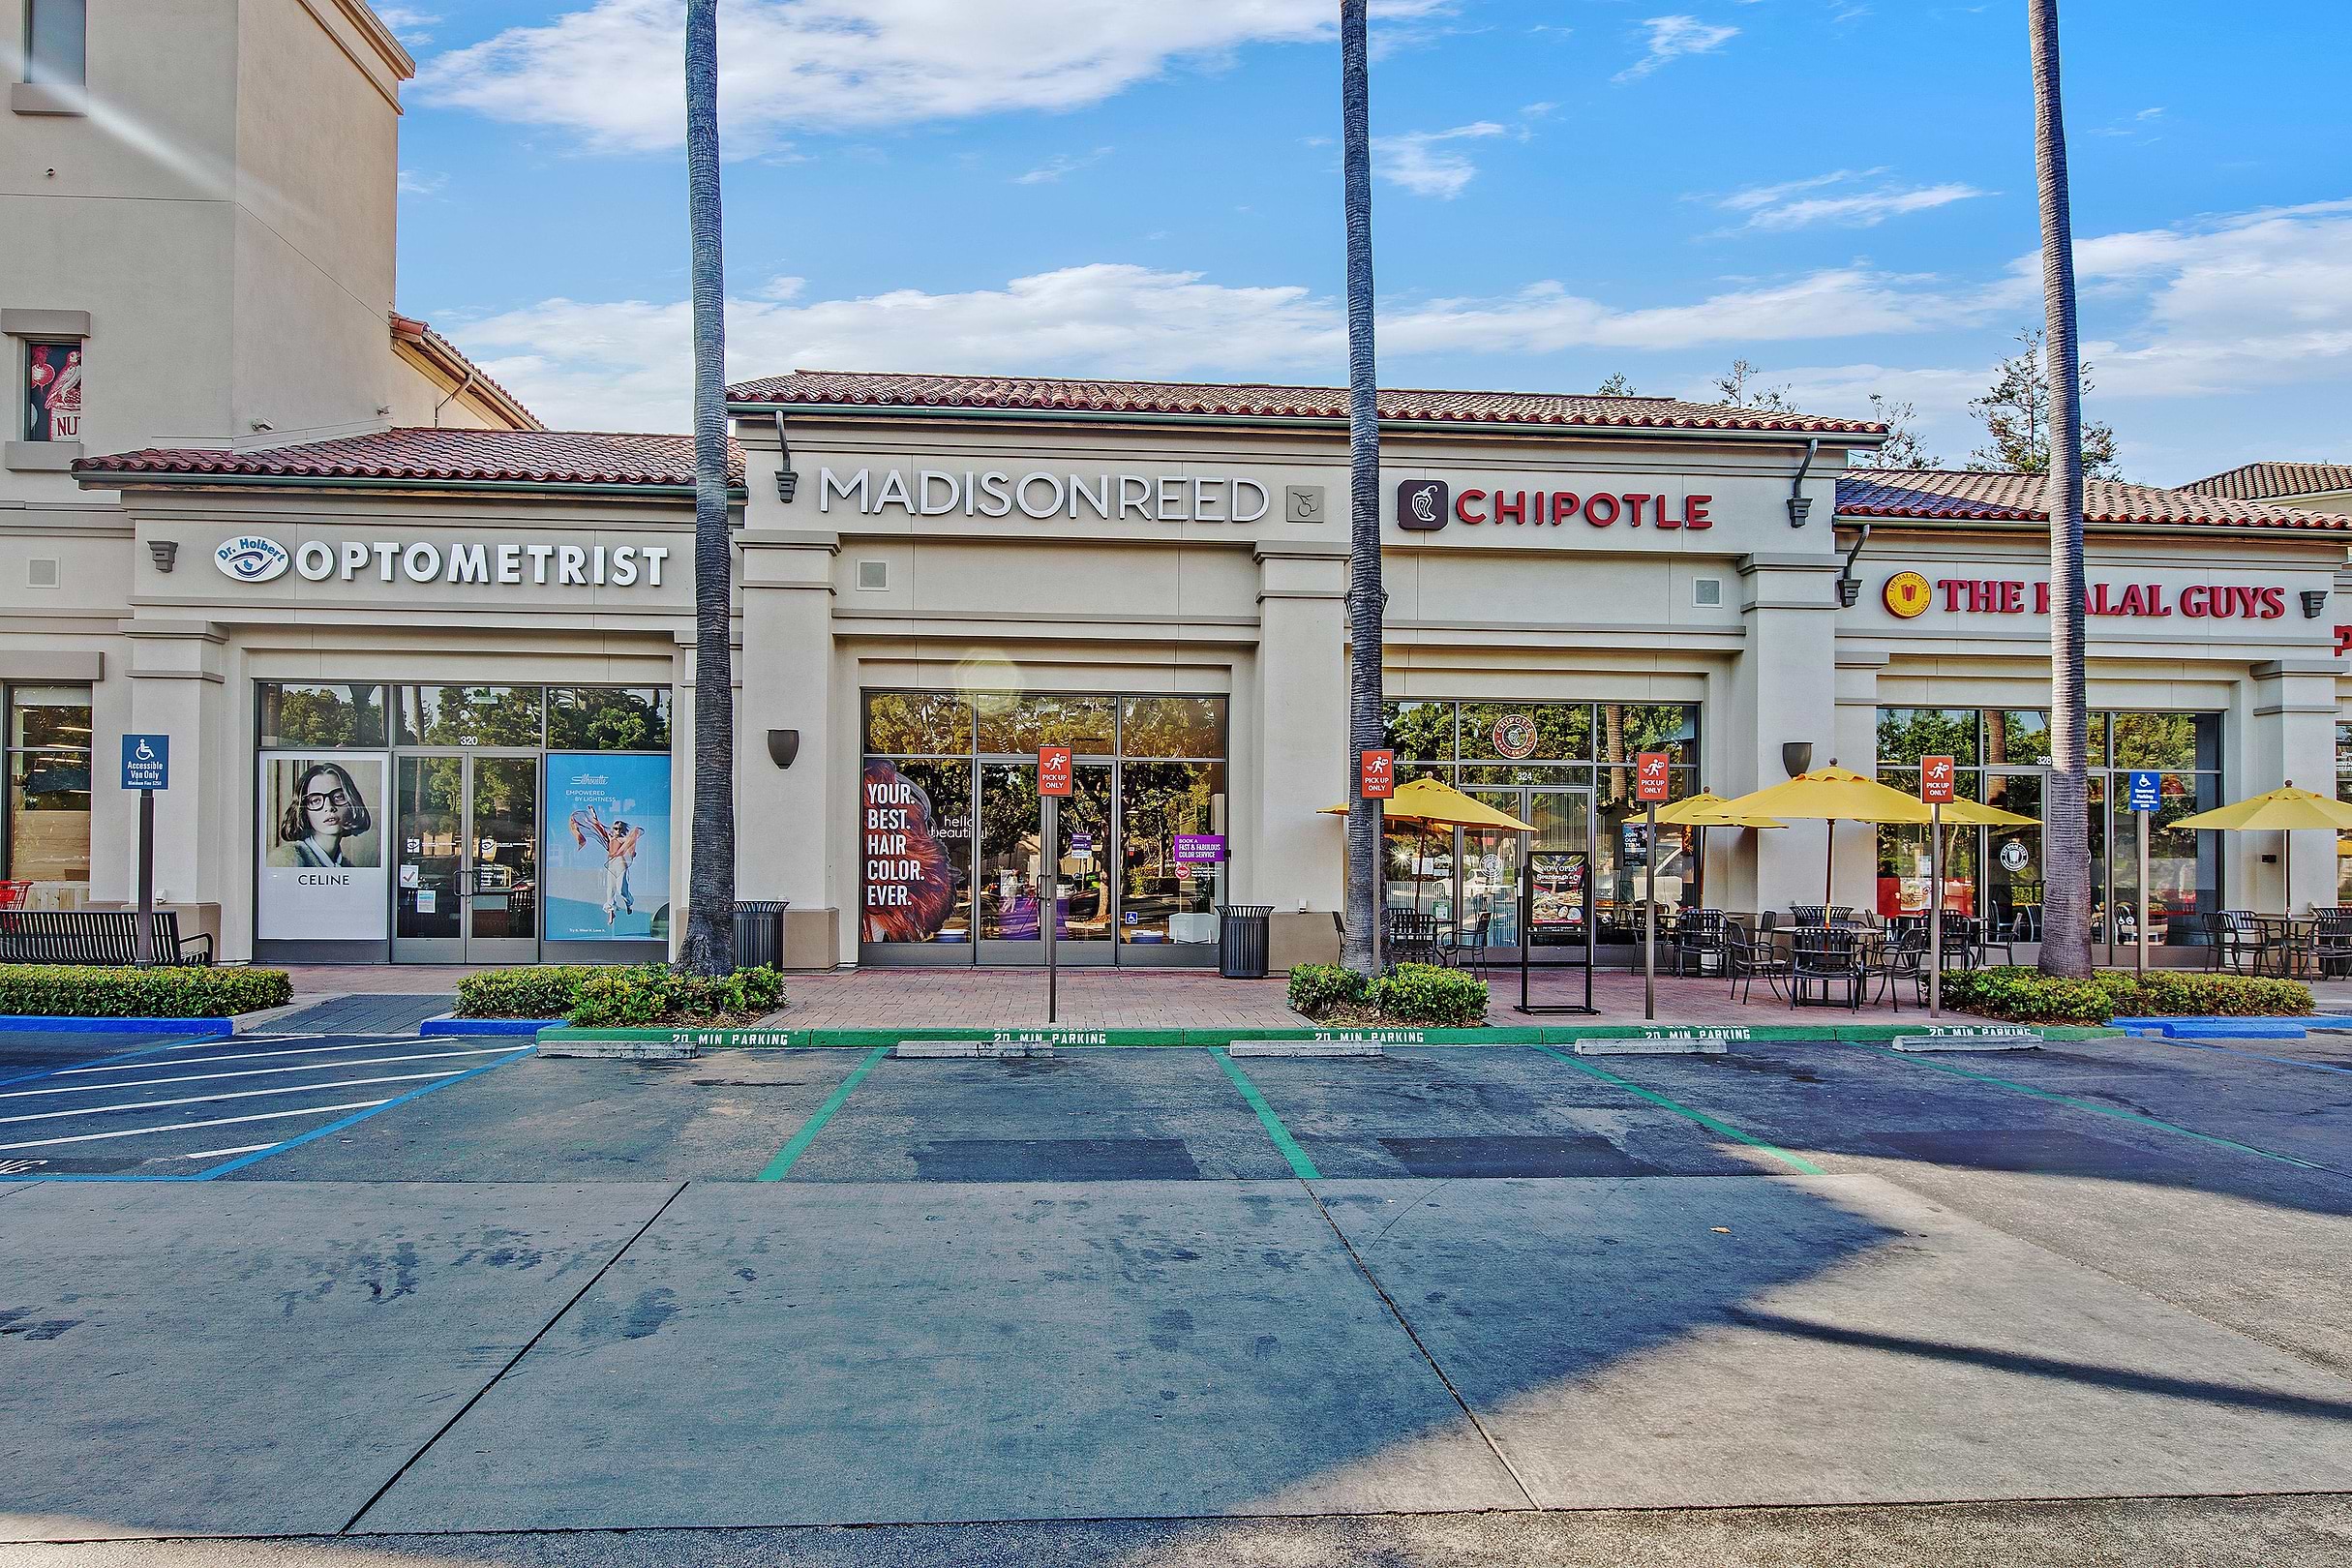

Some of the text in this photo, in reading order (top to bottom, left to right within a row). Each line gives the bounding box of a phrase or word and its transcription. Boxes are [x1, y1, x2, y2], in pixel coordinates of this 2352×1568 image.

[57, 417, 80, 436] NU
[1456, 488, 1713, 528] CHIPOTLE
[217, 538, 286, 562] Dr. Holbert
[295, 540, 669, 587] OPTOMETRIST
[1937, 579, 2285, 618] THE HLAL GUYS
[1496, 716, 1534, 734] CHIPOTLE
[460, 736, 478, 746] 320
[127, 760, 164, 769] Accessible
[2036, 755, 2052, 765] 328
[131, 769, 160, 780] Van Only
[1517, 771, 1532, 780] 324
[867, 783, 916, 805] YOUR.
[867, 808, 911, 829] BEST.
[930, 825, 988, 839] beautiul
[867, 834, 906, 856] HAIR
[867, 859, 925, 881] COLOR.
[298, 874, 350, 887] CELINE
[867, 885, 912, 906] EVER.
[672, 1034, 789, 1045] 20 MIN PARKING
[993, 1033, 1106, 1044] 20 MIN PARKING
[1314, 1032, 1424, 1042] 20 MIN PARKING
[1644, 1029, 1751, 1040] 20 MIN PARKING
[1929, 1028, 2032, 1037] 20 MIN PARKING
